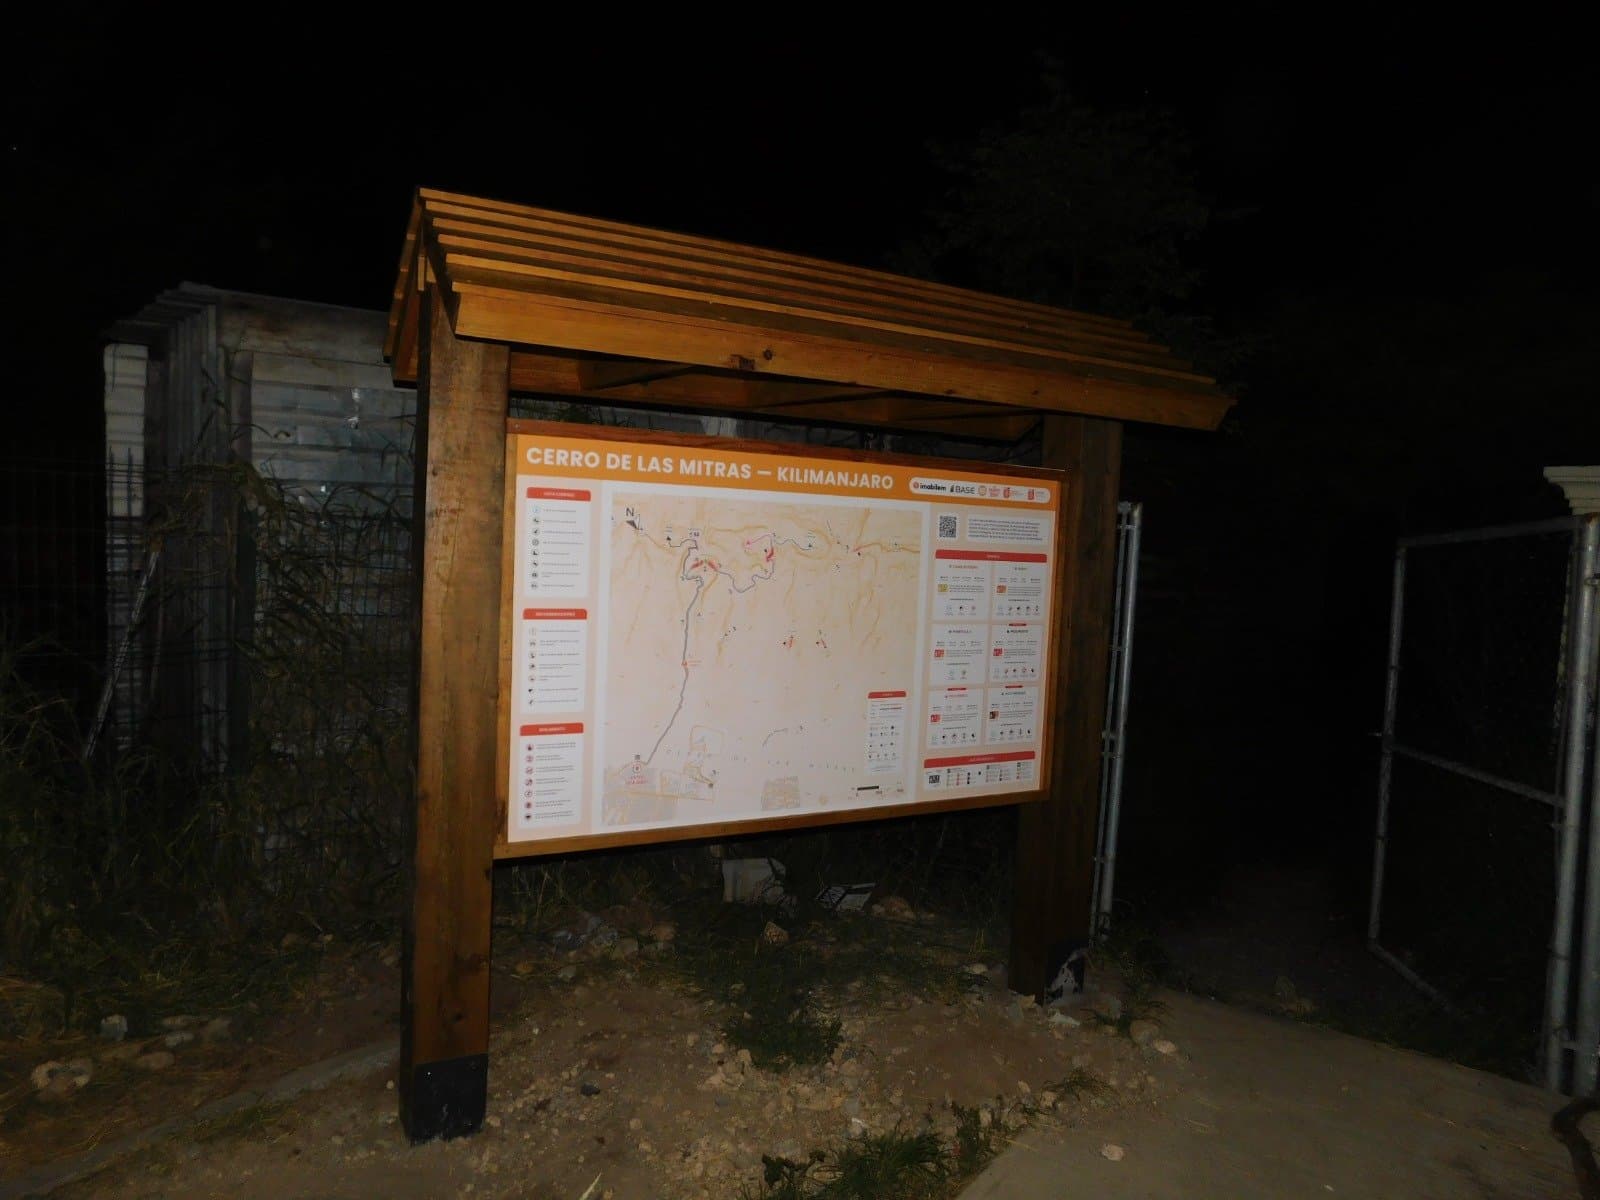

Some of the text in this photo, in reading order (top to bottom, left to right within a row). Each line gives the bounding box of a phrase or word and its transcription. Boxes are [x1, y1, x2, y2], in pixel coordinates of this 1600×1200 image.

[526, 447, 600, 469] CERRO
[607, 453, 632, 472] DE
[638, 456, 674, 474] LAS
[679, 458, 752, 479] MITRAS
[777, 465, 894, 489] KILIMANJARO
[955, 485, 975, 494] BASE
[625, 507, 635, 517] N
